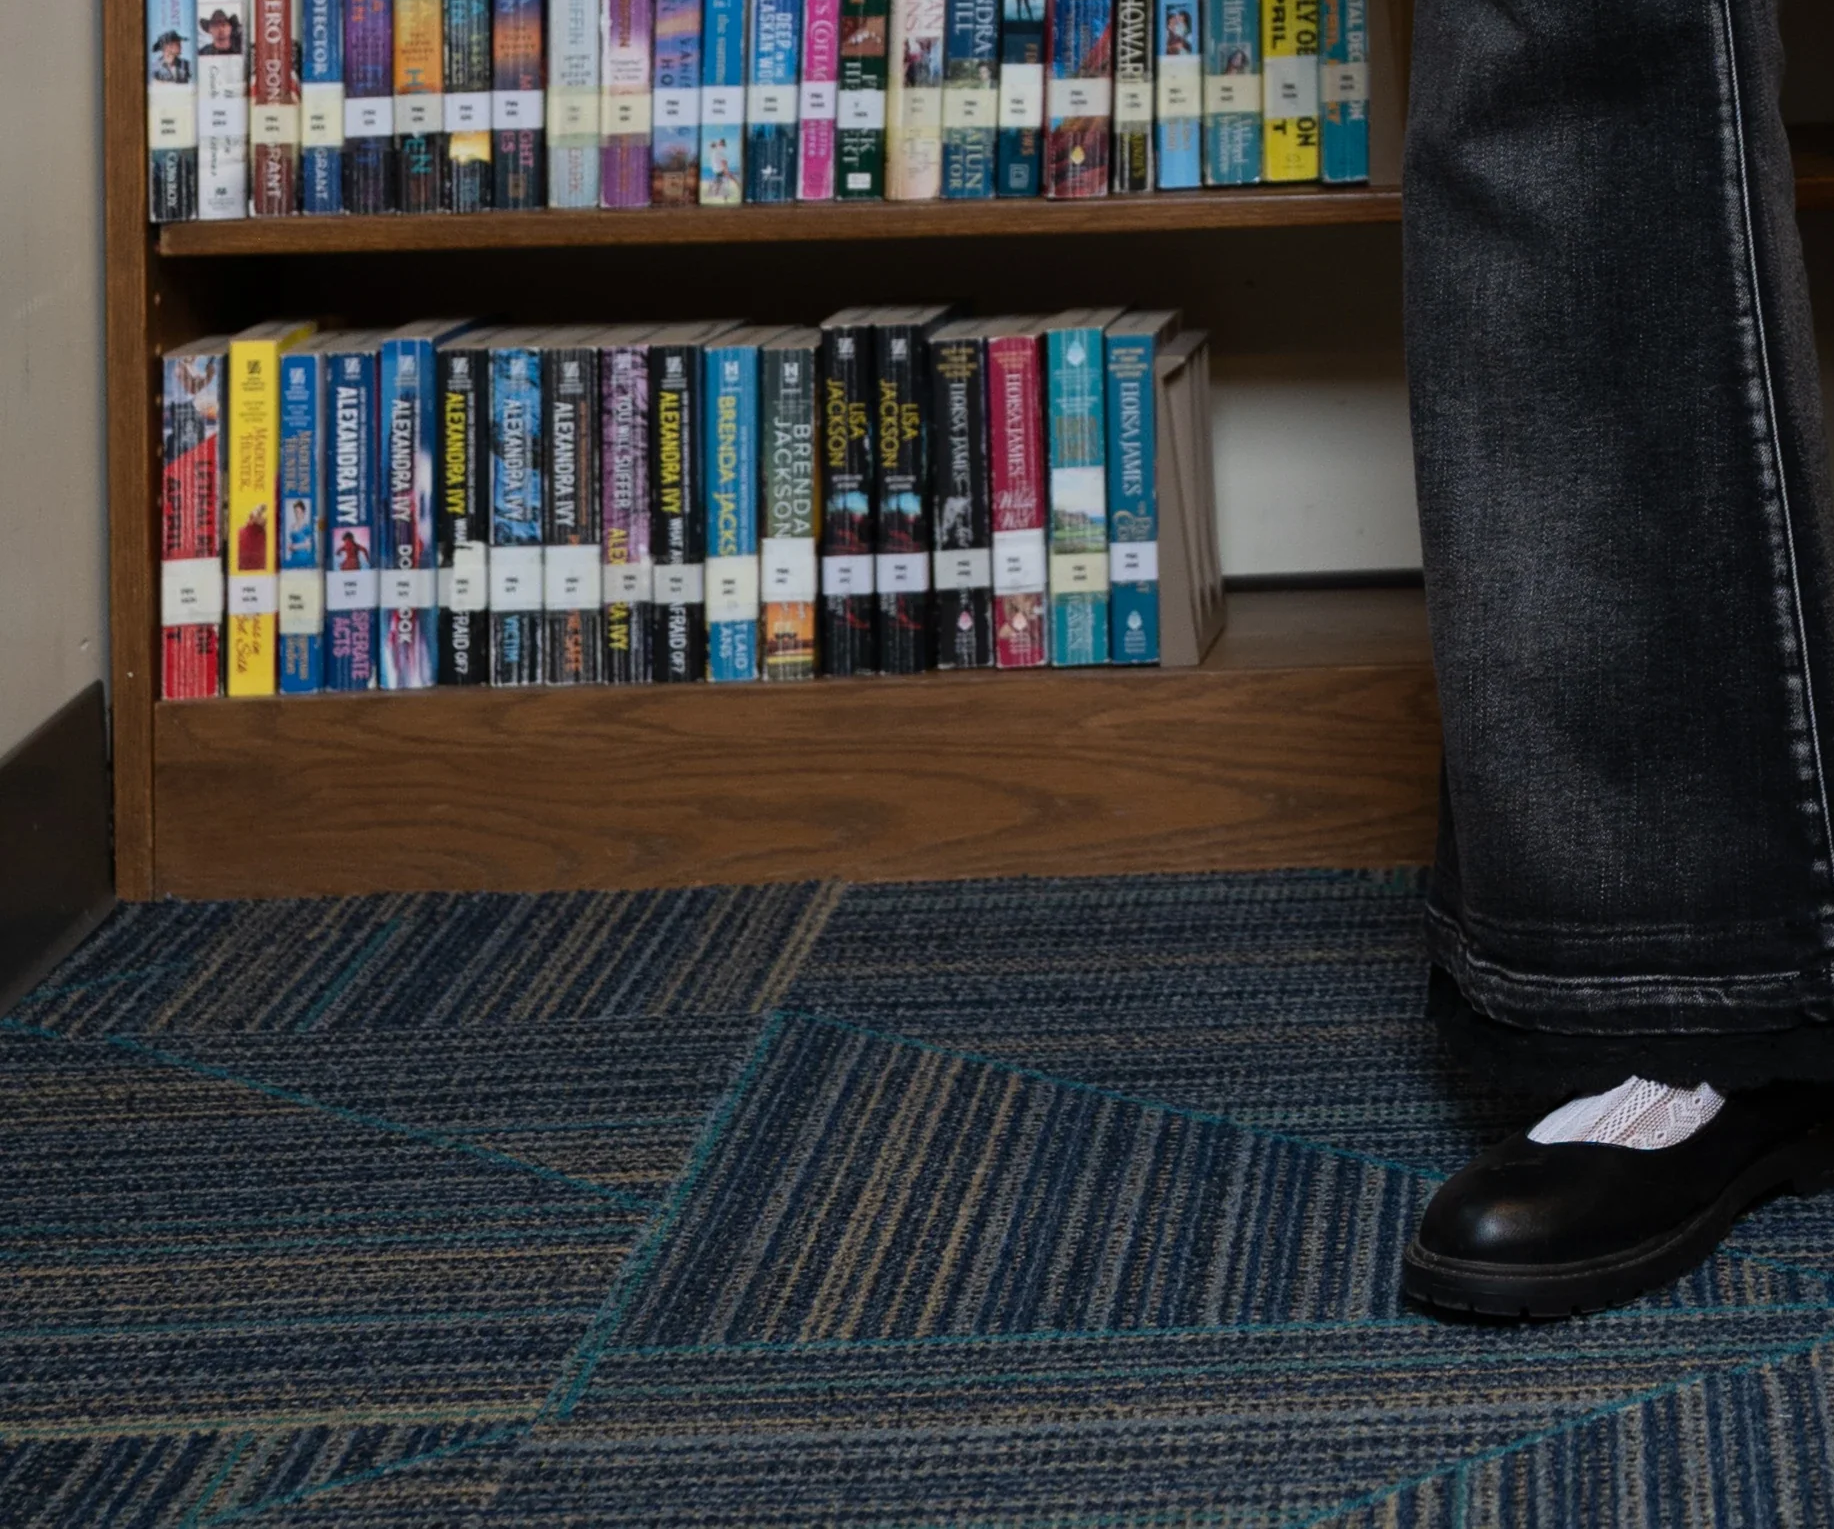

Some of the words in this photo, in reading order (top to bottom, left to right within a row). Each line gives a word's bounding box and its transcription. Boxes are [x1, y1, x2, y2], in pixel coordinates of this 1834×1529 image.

[616, 394, 631, 423] YOU
[827, 378, 847, 467] JACKSON
[848, 402, 866, 440] LISA
[1120, 382, 1139, 438] ELOISA
[336, 386, 357, 491] ALEXANDRA
[554, 401, 574, 496] ALEXANDRA
[196, 459, 212, 527] LETHAL
[616, 455, 632, 509] SUFFER
[1122, 441, 1142, 496] JAMES
[336, 495, 357, 524] IVY
[555, 501, 575, 527] IVY
[669, 518, 683, 548] WHAT
[504, 616, 520, 663] VICTIM
